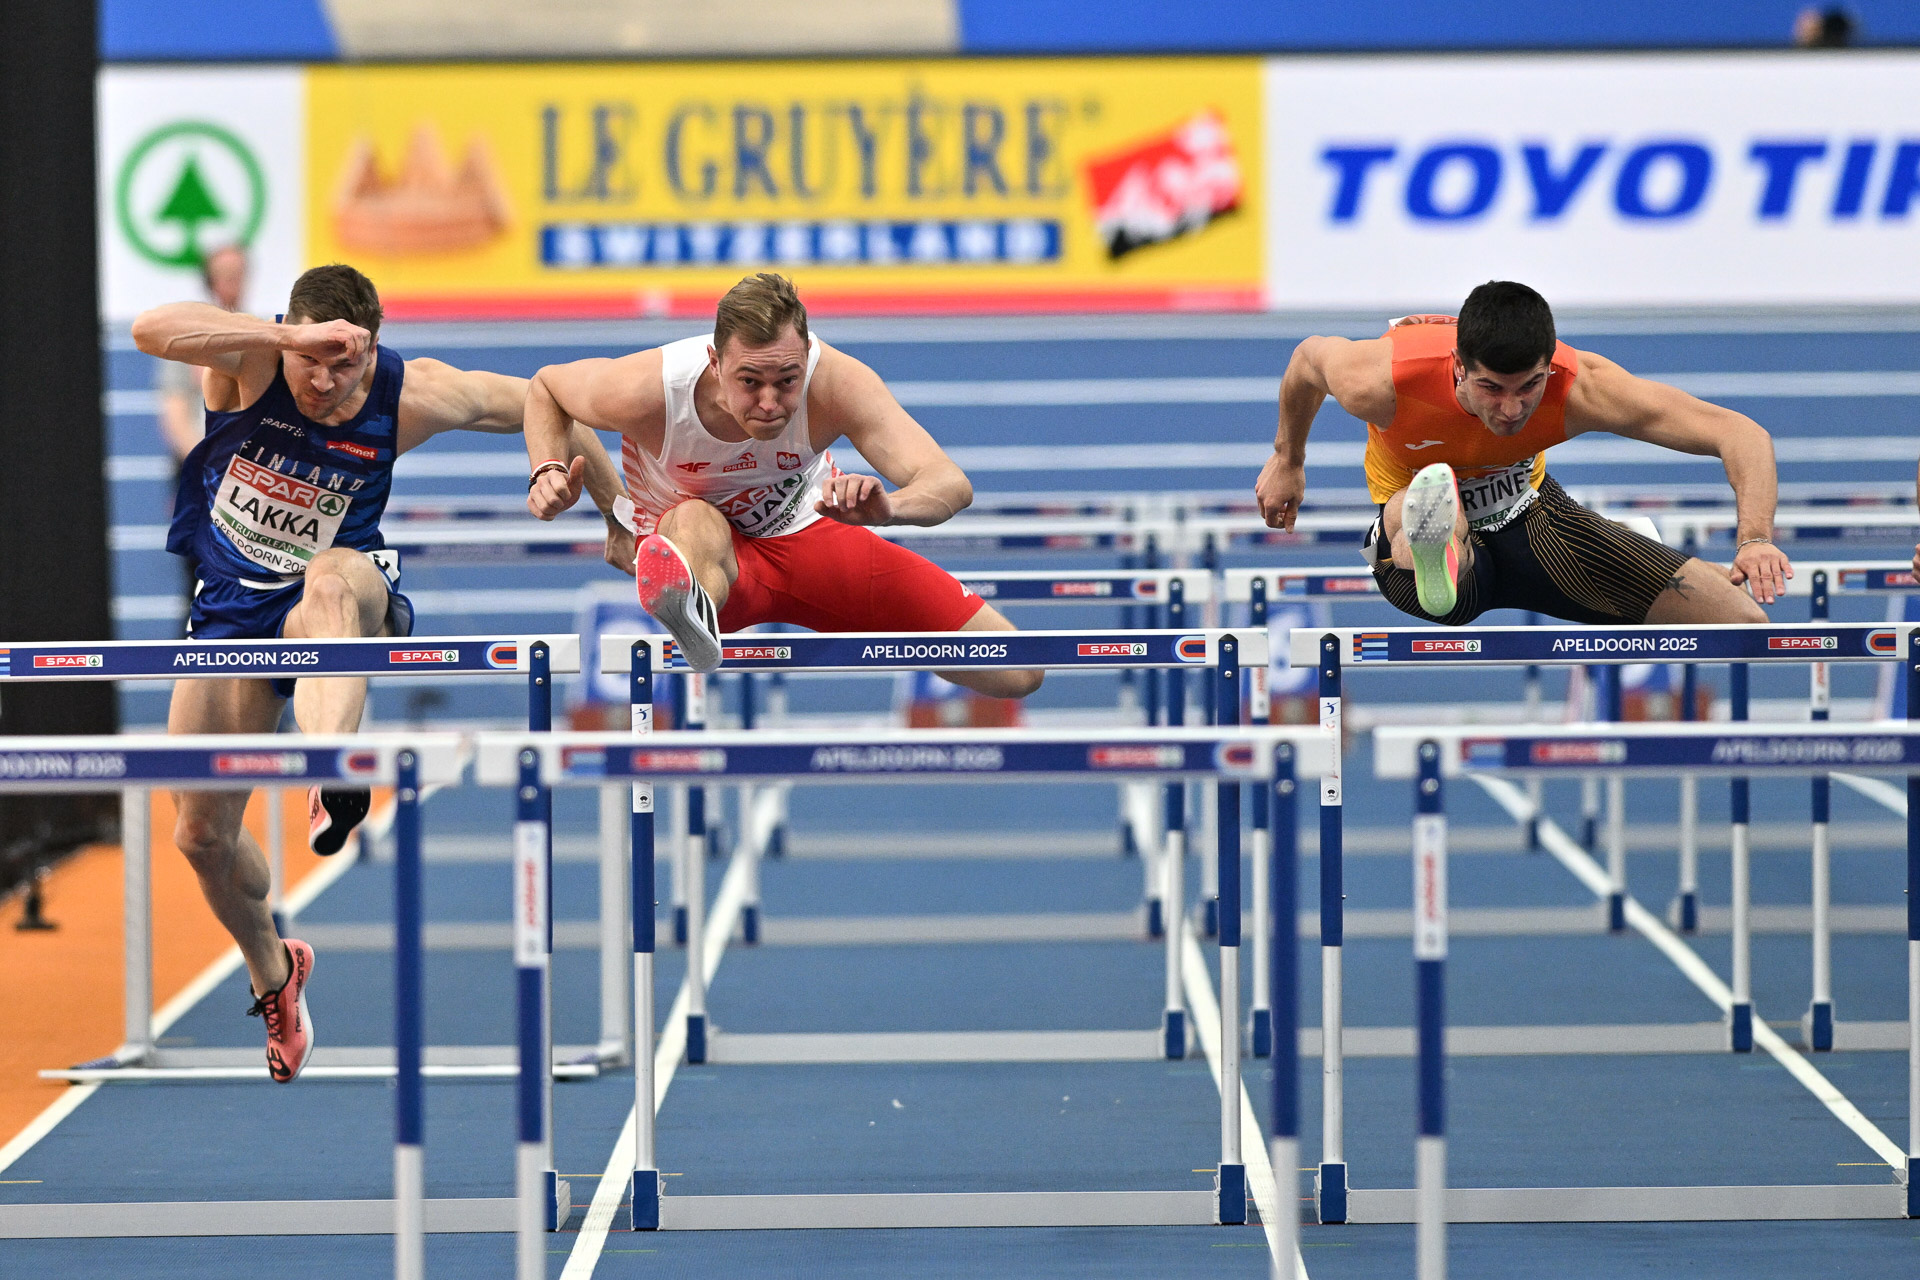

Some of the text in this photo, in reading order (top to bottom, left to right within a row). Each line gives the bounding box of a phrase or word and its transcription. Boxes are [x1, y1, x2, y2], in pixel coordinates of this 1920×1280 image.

[541, 84, 1074, 202] LE GRUYÈRE
[1319, 140, 1714, 221] TOYO
[724, 462, 755, 471] ORLEN
[232, 461, 316, 506] SPAR
[229, 486, 320, 543] LAKKA
[1482, 508, 1511, 527] CLEA
[236, 522, 259, 541] RUN
[259, 536, 296, 554] CLEAN
[284, 559, 306, 573] 202
[734, 644, 1129, 659] SPAR APELDOORN 2025 SPAR
[1424, 637, 1820, 652] SPAR APELDOORN 2025 SPAR
[46, 651, 441, 666] SPAR APELDOORN 2025 SPAR
